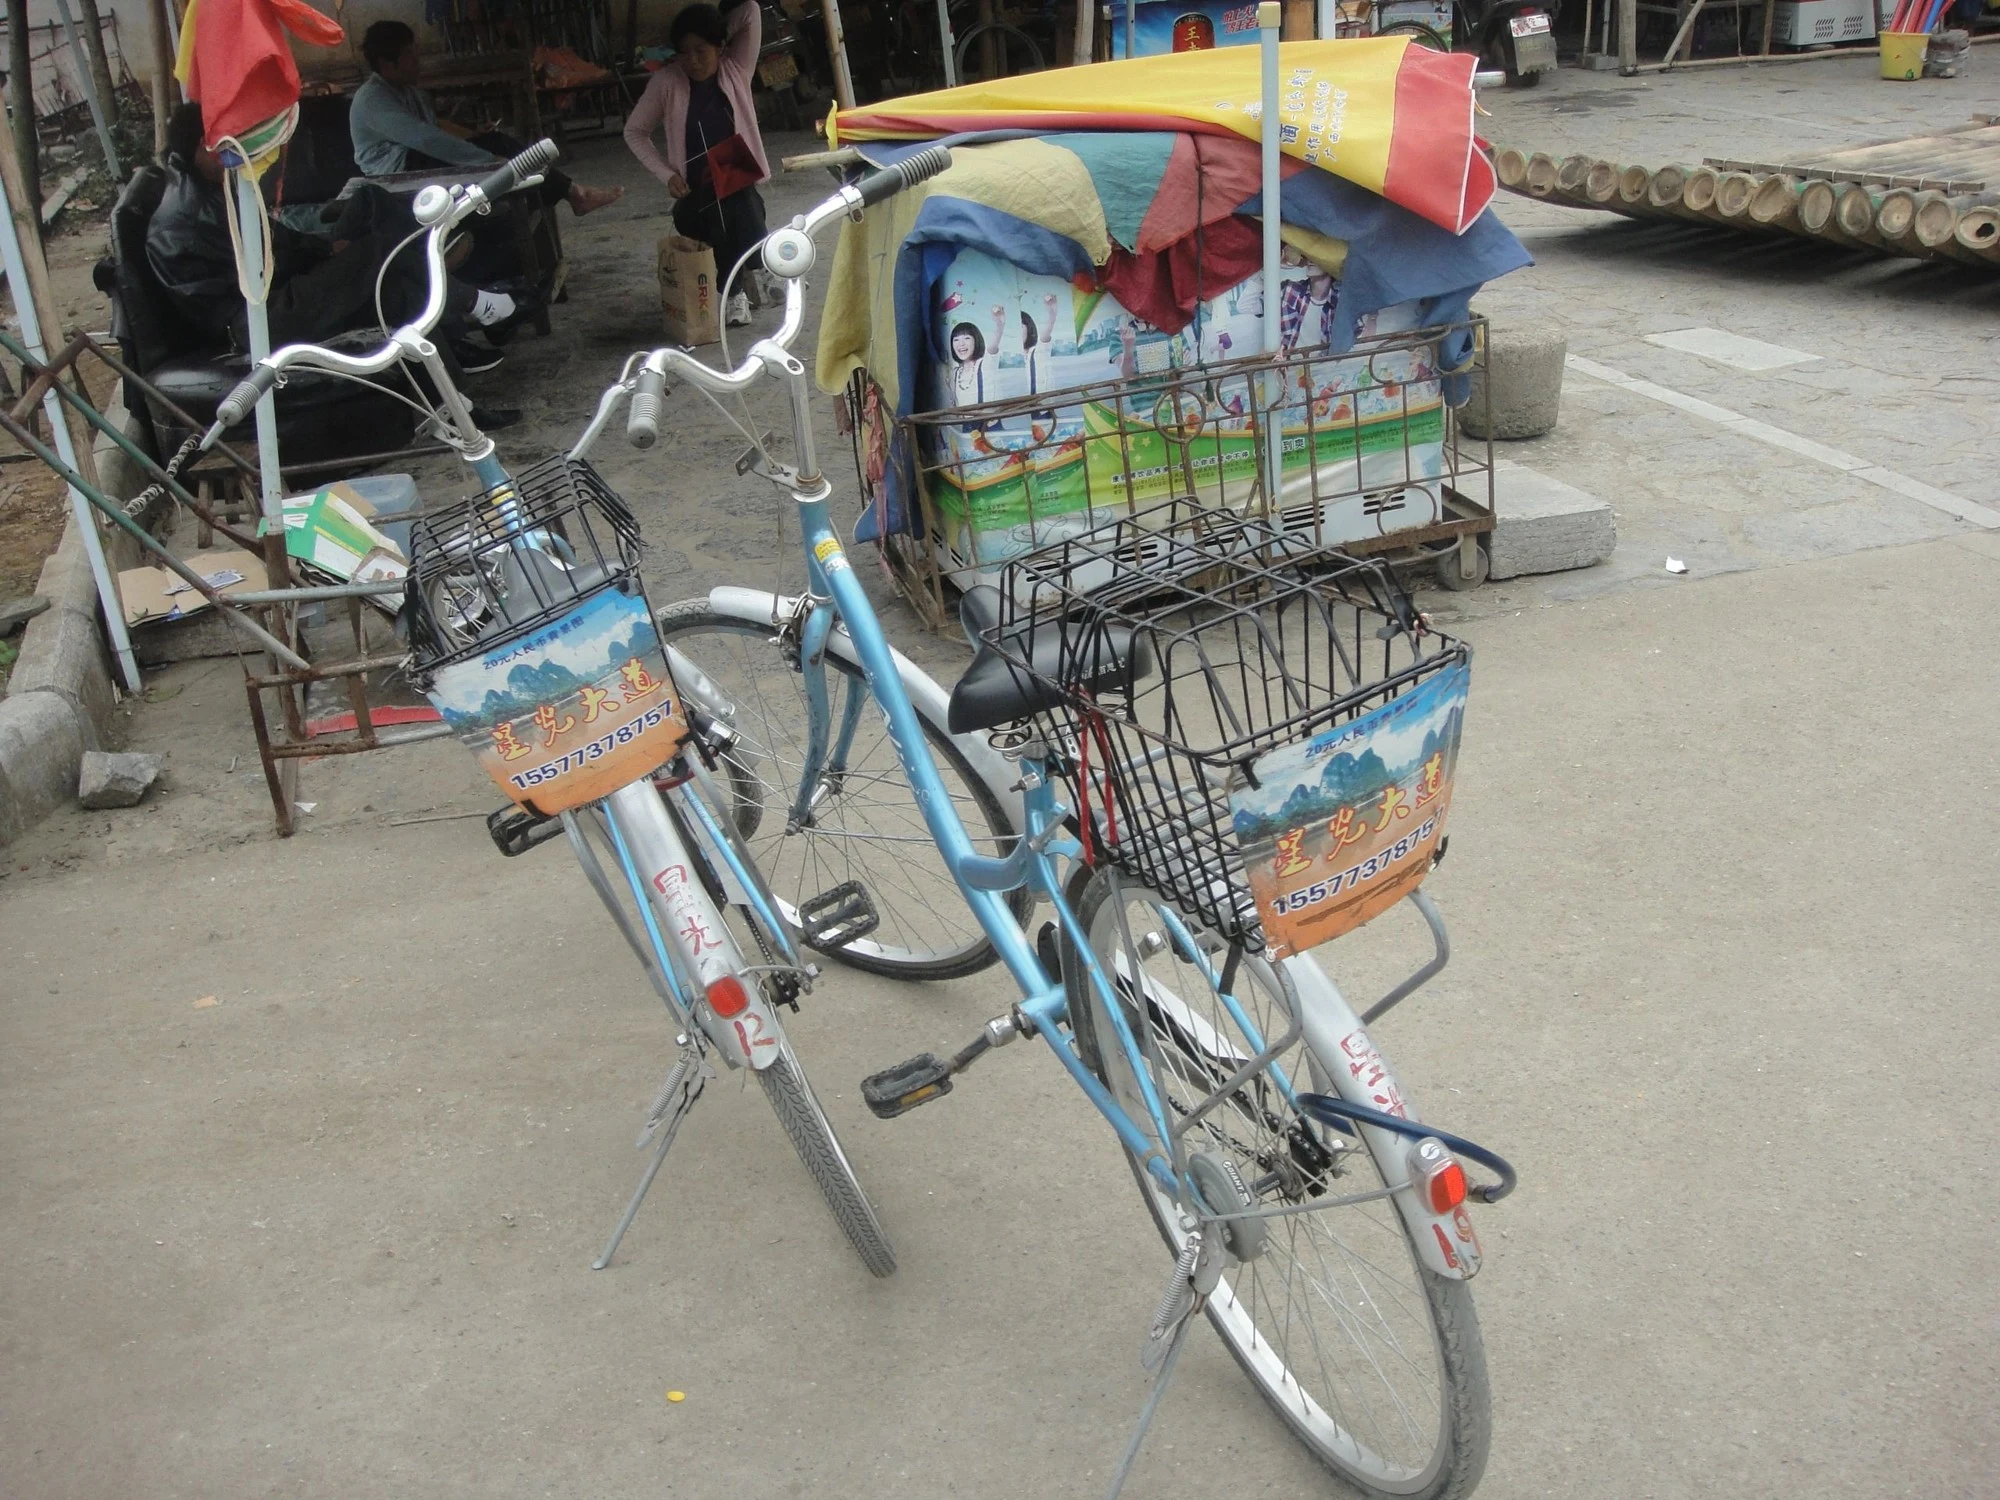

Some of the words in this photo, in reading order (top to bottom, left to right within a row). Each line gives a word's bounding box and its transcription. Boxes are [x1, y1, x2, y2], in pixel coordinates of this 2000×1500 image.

[492, 657, 662, 761] 星光大道
[510, 699, 673, 790] 15577378757
[1273, 751, 1443, 878] 星光大道
[1226, 1166, 1245, 1191] GIANT
